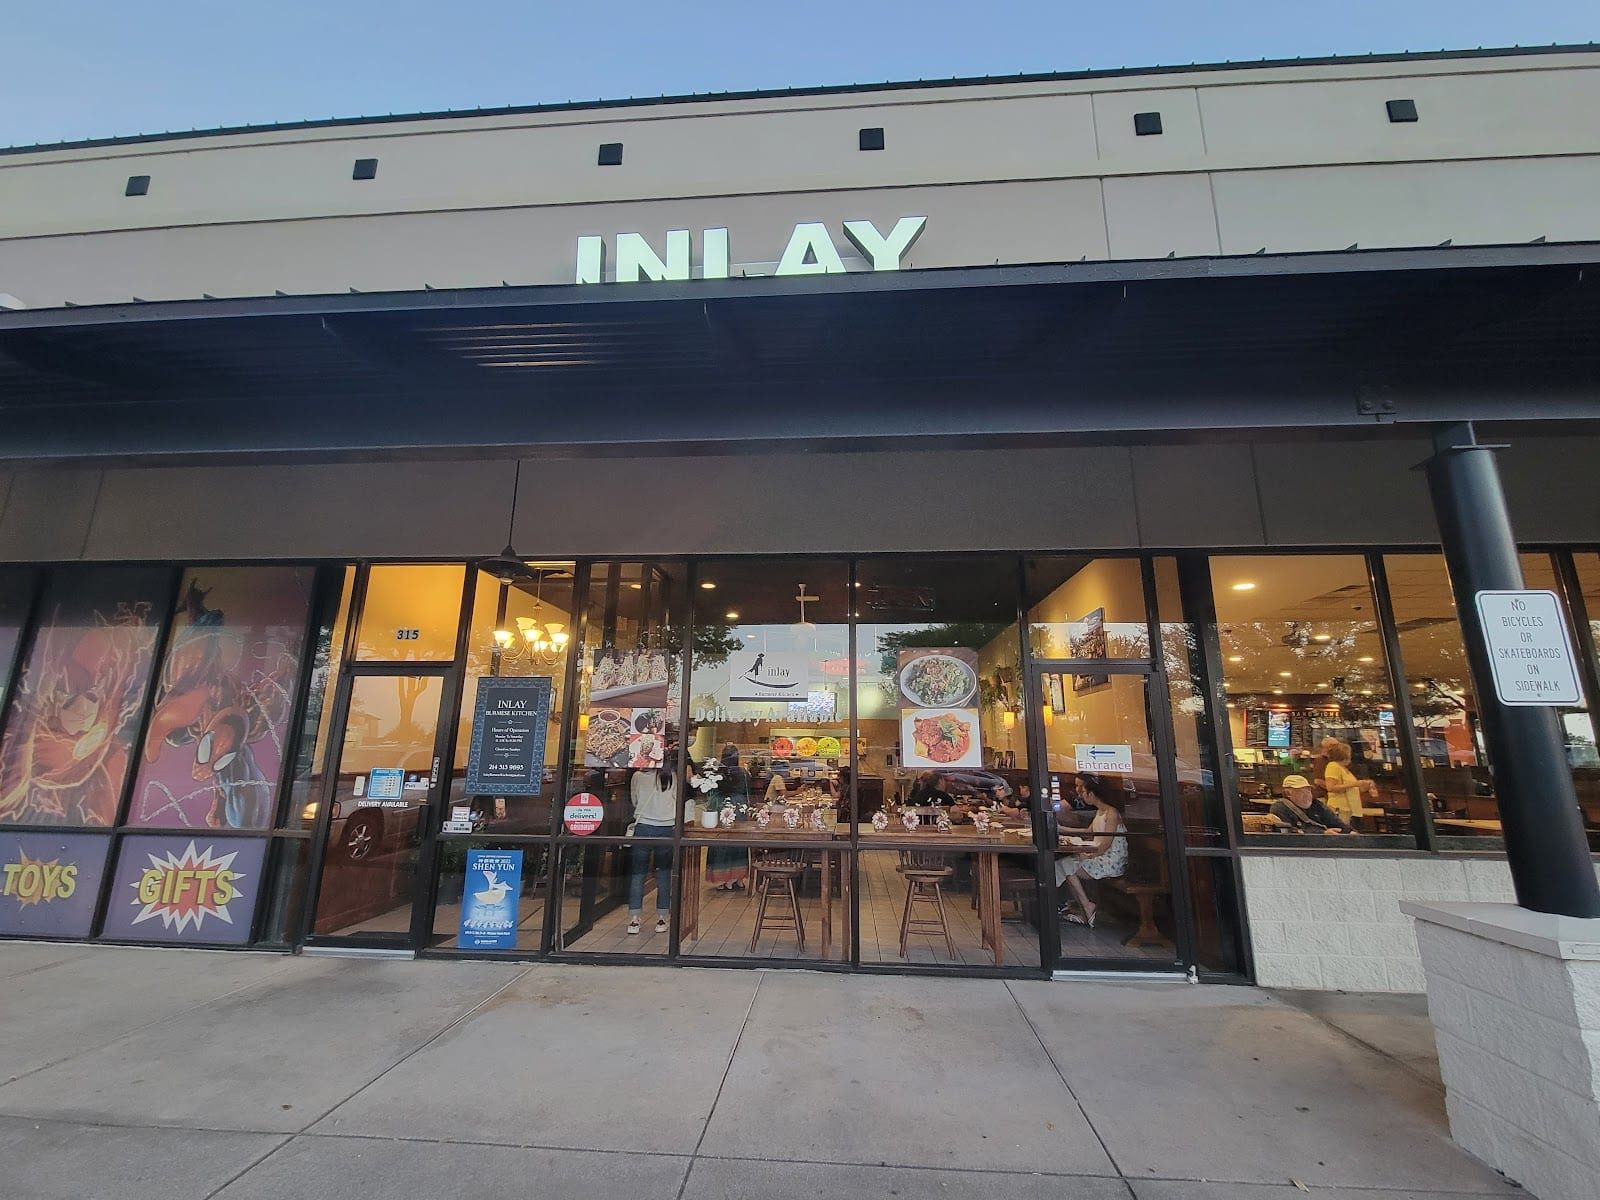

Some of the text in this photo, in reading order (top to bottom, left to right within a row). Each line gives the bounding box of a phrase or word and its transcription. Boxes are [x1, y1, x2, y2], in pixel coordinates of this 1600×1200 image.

[576, 216, 928, 285] INLAY
[1511, 600, 1526, 611] NO
[1501, 616, 1544, 627] BICYCLES
[397, 629, 419, 640] 315
[1520, 632, 1533, 643] OR
[1498, 647, 1561, 659] SKATEBOARDS
[767, 666, 790, 678] inlay
[1526, 664, 1540, 675] ON
[1515, 680, 1561, 692] SIDEWALK
[497, 700, 528, 709] INLAY
[695, 704, 763, 727] Delivery
[1077, 760, 1132, 770] Entrance
[357, 800, 381, 808] DELIVERY
[472, 862, 515, 871] SHEN YUN
[3, 863, 78, 898] TOYS
[138, 869, 234, 905] GIFTS
